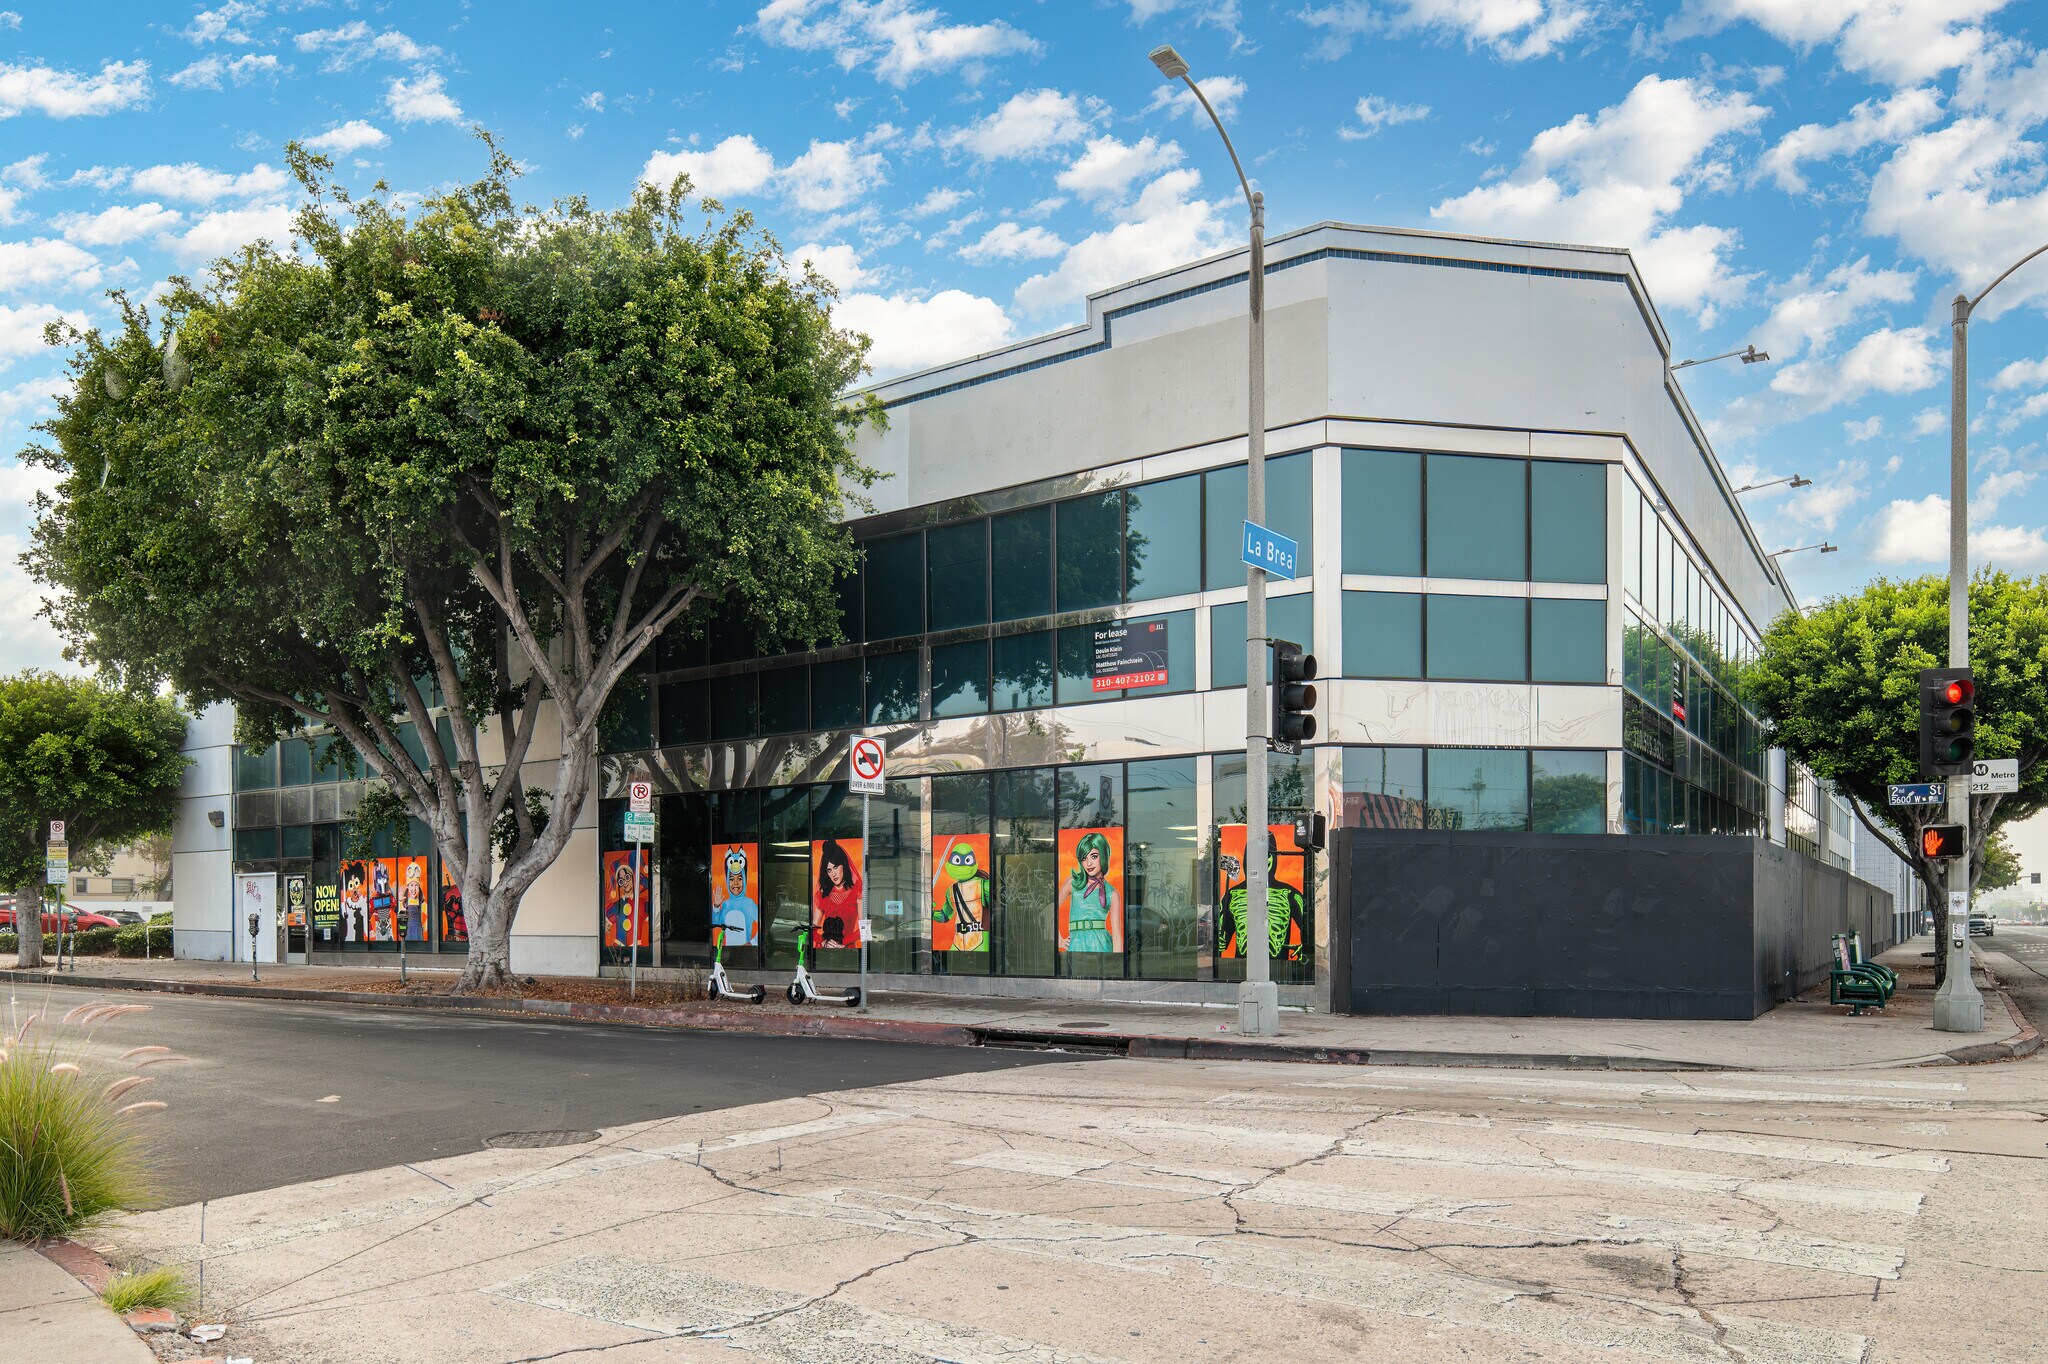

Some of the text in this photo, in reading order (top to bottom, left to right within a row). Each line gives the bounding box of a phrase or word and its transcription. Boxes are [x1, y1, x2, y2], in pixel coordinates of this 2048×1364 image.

[1248, 532, 1292, 570] La Brea
[1095, 629, 1128, 640] For lease
[1096, 674, 1155, 687] 310-407-2102
[1891, 785, 1942, 796] 2nd St
[316, 885, 336, 898] NOW
[314, 899, 340, 912] OPEN!
